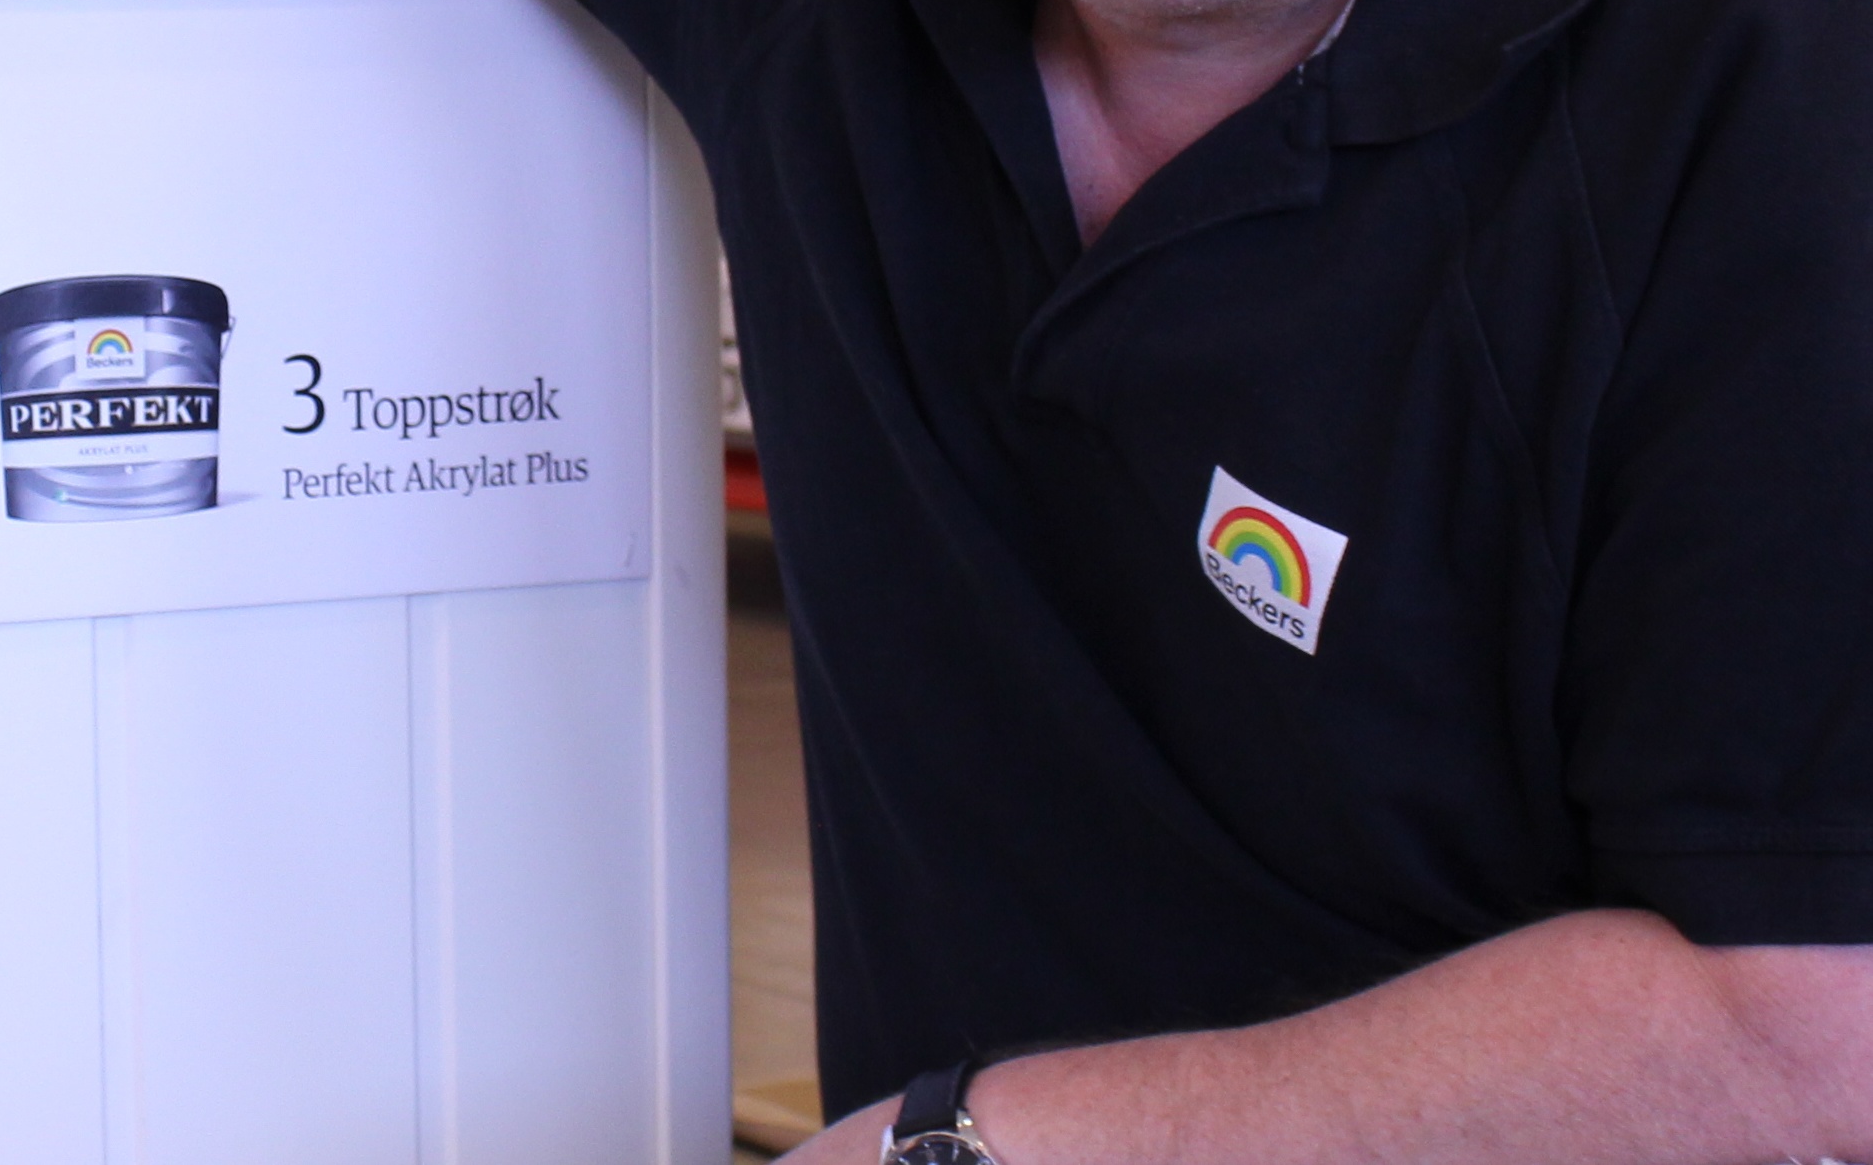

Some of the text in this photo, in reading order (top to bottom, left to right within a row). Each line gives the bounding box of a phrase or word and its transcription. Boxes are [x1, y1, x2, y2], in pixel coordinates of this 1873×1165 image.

[86, 355, 134, 369] Beckers
[10, 395, 213, 434] PERFEKT
[281, 353, 562, 440] 3 Toppstrøk
[282, 450, 590, 500] Perfekt Akrylat Plus
[1206, 553, 1306, 639] Beckers
